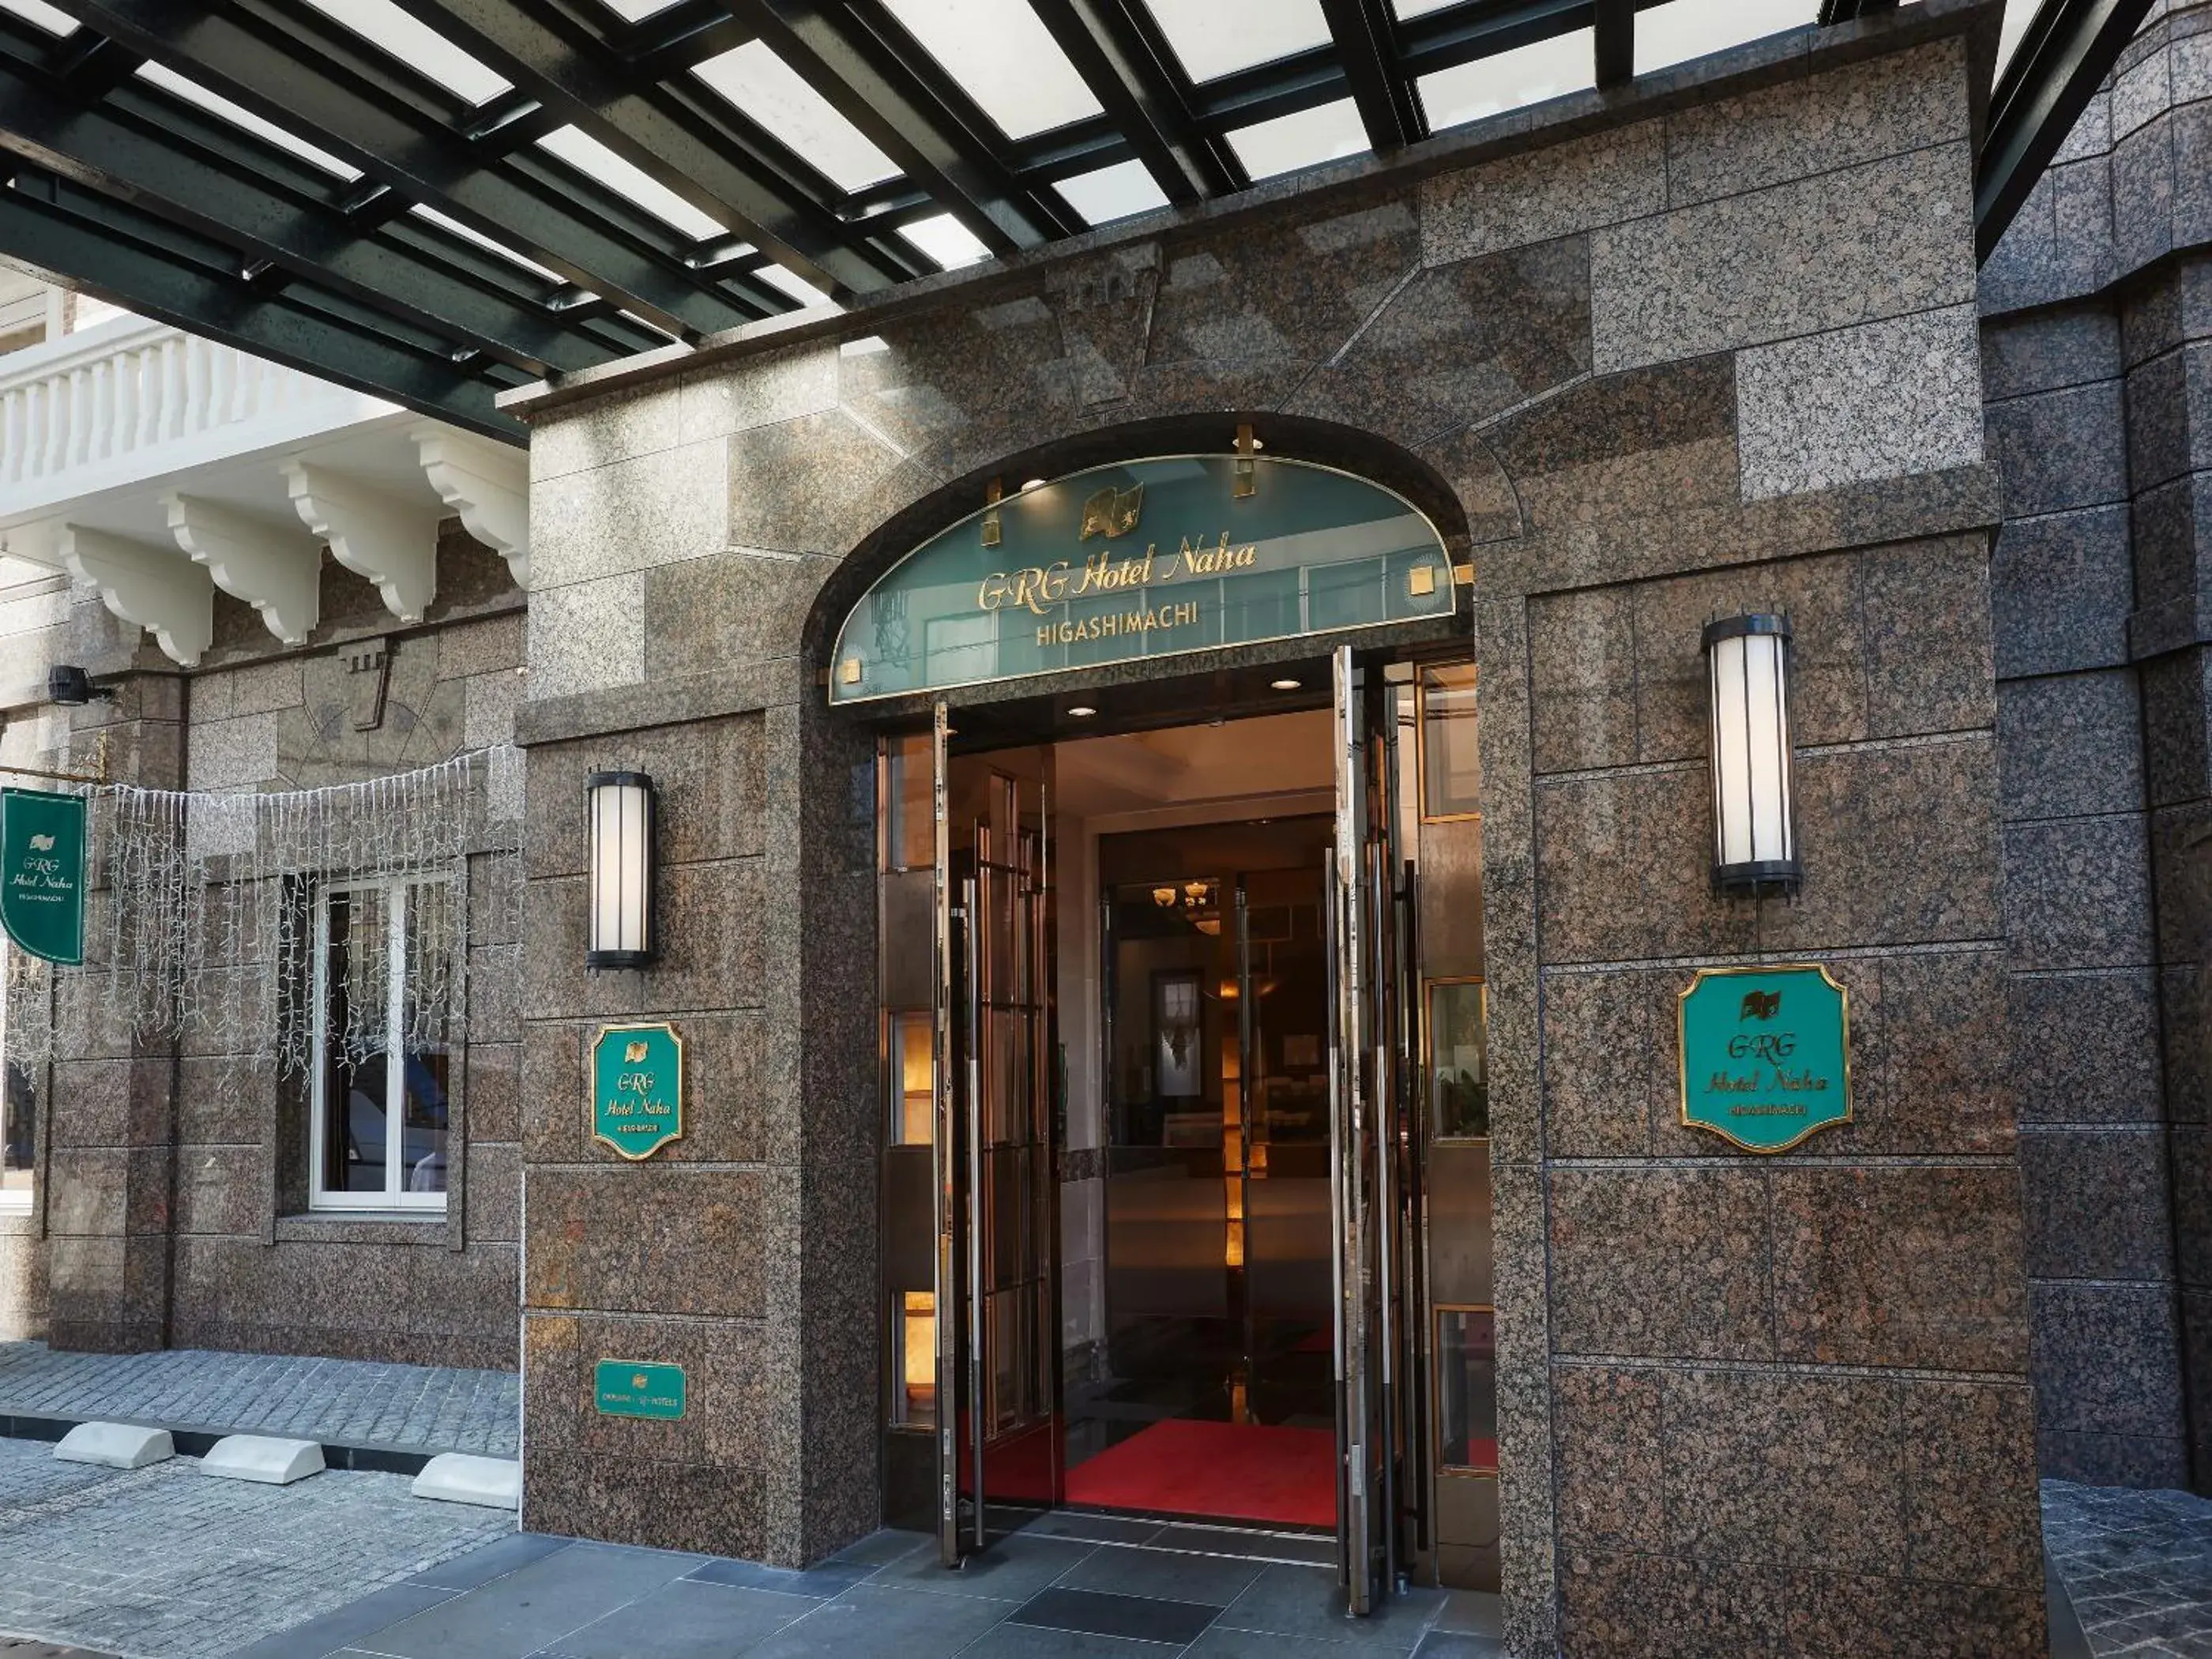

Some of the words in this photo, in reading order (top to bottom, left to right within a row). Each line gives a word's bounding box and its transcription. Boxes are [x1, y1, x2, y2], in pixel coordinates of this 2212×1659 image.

[978, 560, 1071, 615] GRG
[1073, 542, 1157, 594] Hotel
[1164, 529, 1258, 580] Naha
[1035, 601, 1199, 648] HIGASHIMACHI
[1729, 1032, 1796, 1065] GRG
[618, 1071, 656, 1095] GRG
[1703, 1070, 1761, 1096] Hotel
[1766, 1067, 1830, 1093] Naha
[604, 1098, 635, 1117] Hotel
[637, 1098, 672, 1116] Naha
